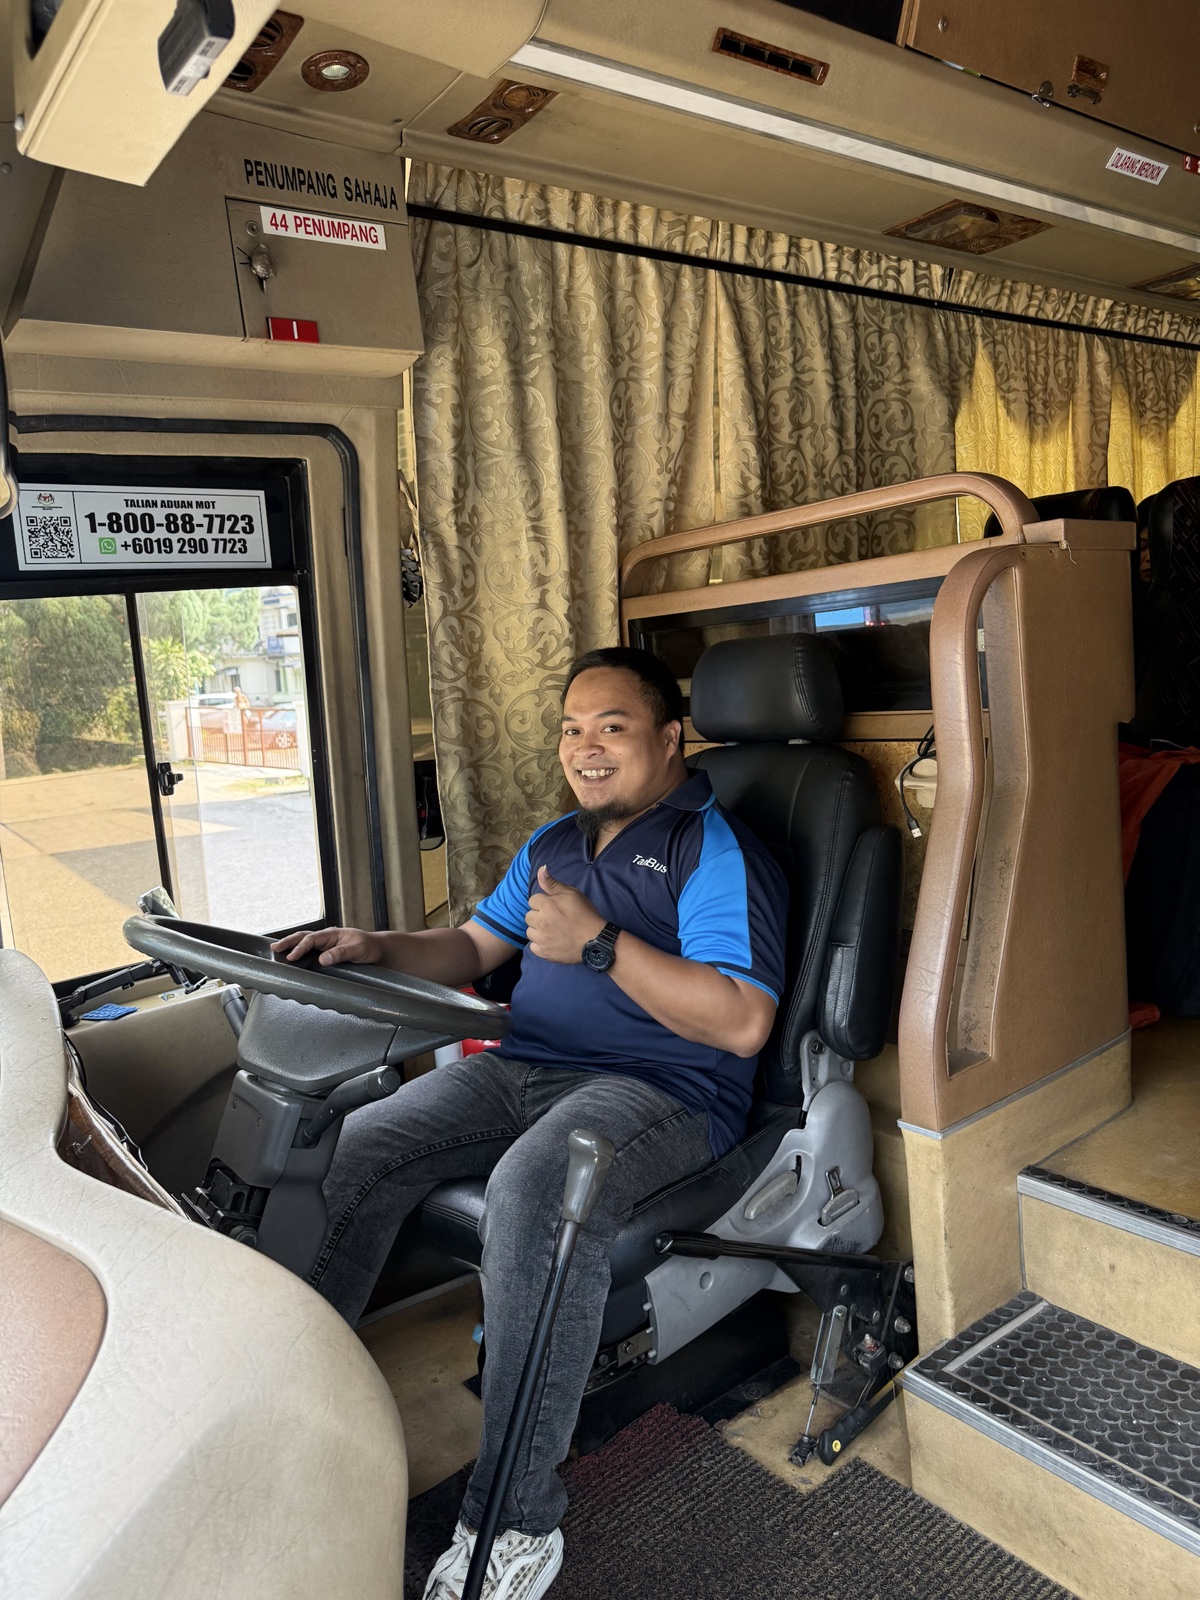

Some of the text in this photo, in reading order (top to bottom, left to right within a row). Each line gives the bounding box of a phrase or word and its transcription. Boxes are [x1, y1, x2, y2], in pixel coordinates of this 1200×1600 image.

[244, 159, 338, 199] PENUMPANG
[343, 177, 399, 210] SAHAJA
[269, 212, 379, 245] 44 PENUMPANG
[123, 498, 216, 510] TALIAN ADUAN MOT
[84, 512, 255, 535] 1-800-88-7723
[120, 537, 248, 555] +6019 290 7723
